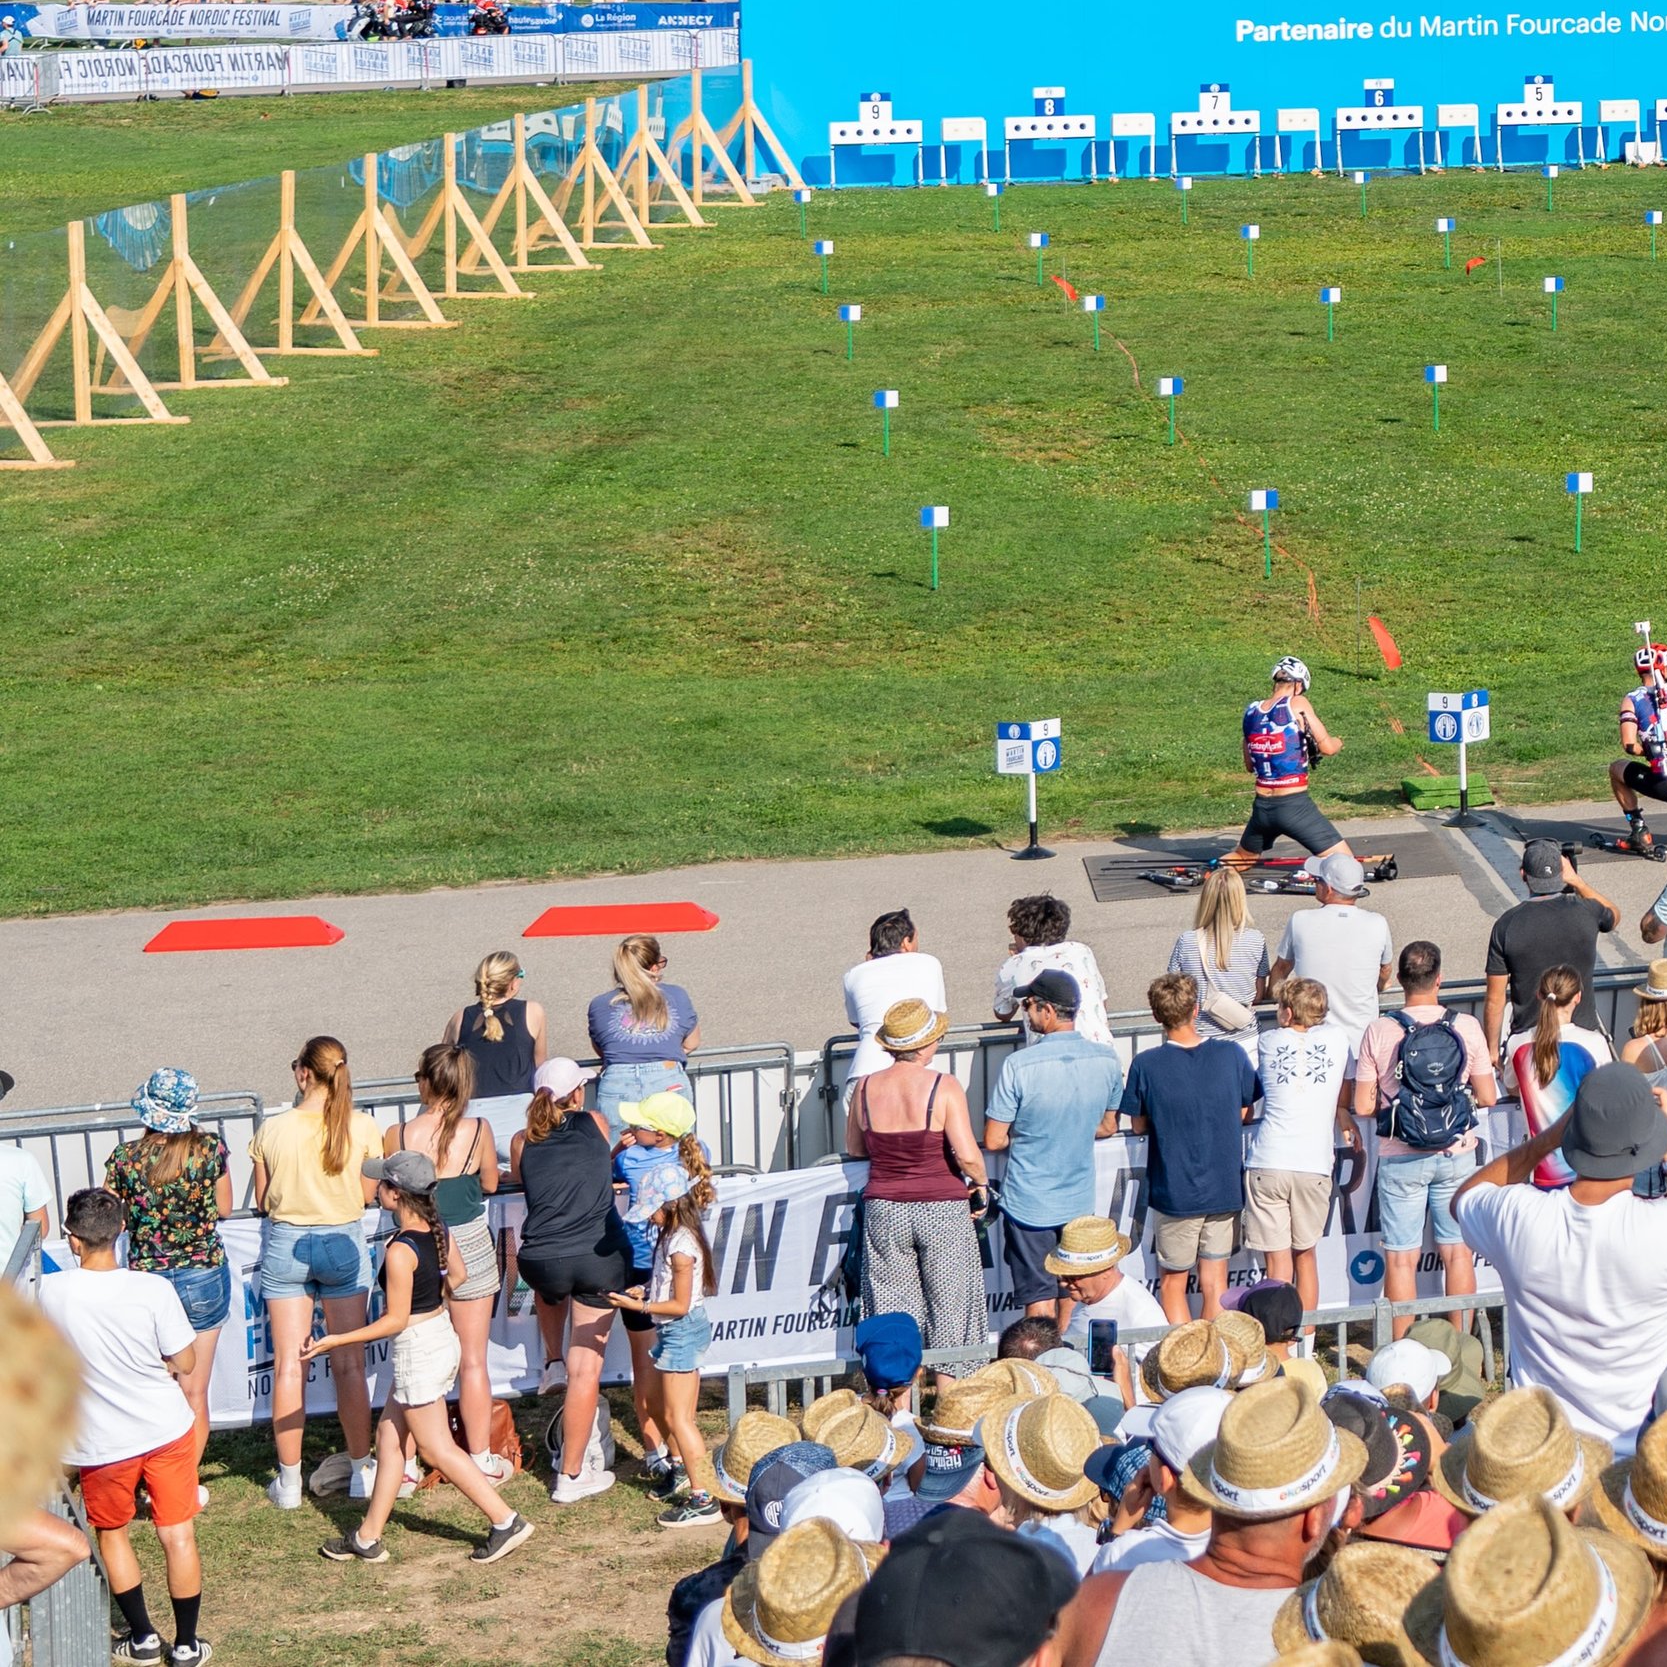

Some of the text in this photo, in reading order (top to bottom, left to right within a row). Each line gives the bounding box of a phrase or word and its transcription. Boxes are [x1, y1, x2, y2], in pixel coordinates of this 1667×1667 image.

[87, 9, 281, 26] MARTIN FOURCADE NORDIC FESTIVAL
[606, 12, 637, 23] Région
[1236, 18, 1373, 42] Partenaire
[1379, 14, 1412, 39] du
[1419, 11, 1498, 38] Martin
[1506, 9, 1622, 36] Fourcade
[1212, 95, 1219, 110] 7
[1374, 90, 1384, 107] 6
[1535, 86, 1543, 102] 5
[872, 104, 880, 120] 9
[1044, 98, 1055, 115] 8
[1442, 693, 1479, 709] 9 8
[1043, 723, 1049, 736] 9
[772, 1308, 857, 1335] FOURCAD
[1016, 1466, 1050, 1497] ekosport
[1279, 1462, 1328, 1501] ekosport
[1552, 1474, 1577, 1501] sport
